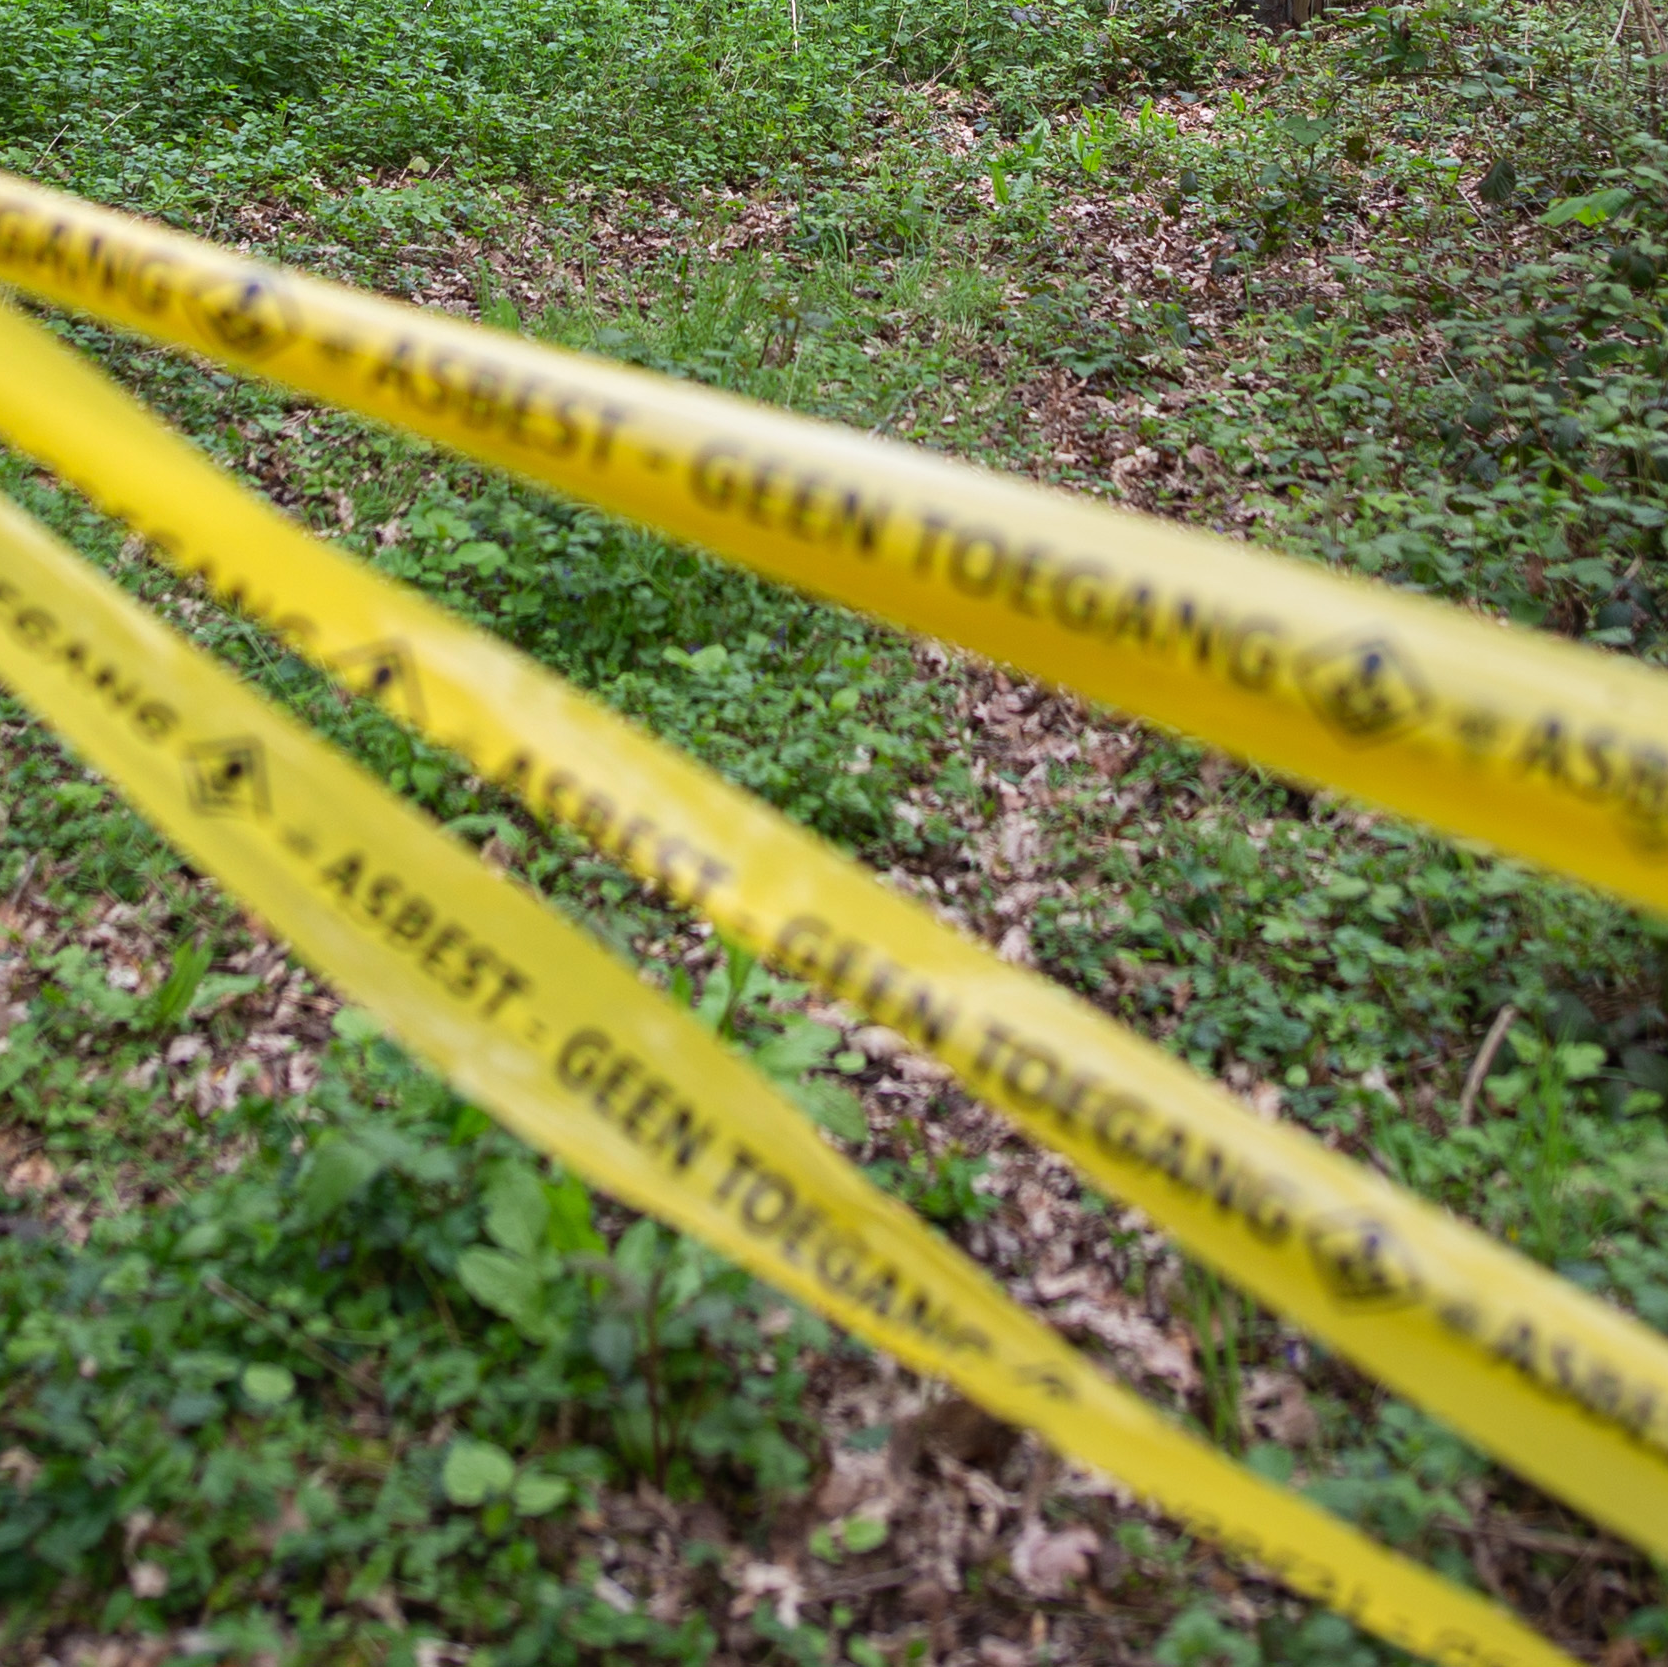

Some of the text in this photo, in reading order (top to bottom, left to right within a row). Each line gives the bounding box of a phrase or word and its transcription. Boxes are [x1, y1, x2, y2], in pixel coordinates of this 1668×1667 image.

[368, 337, 638, 472] ASBEST
[688, 436, 893, 556] GEEN
[909, 510, 1288, 694] TOEGANG
[321, 849, 531, 1019] ASBEST
[555, 1025, 721, 1179] GEEN
[713, 1147, 998, 1360] TOEGANG
[776, 912, 957, 1047] GEEN
[973, 1022, 1293, 1245] TOEGANG
